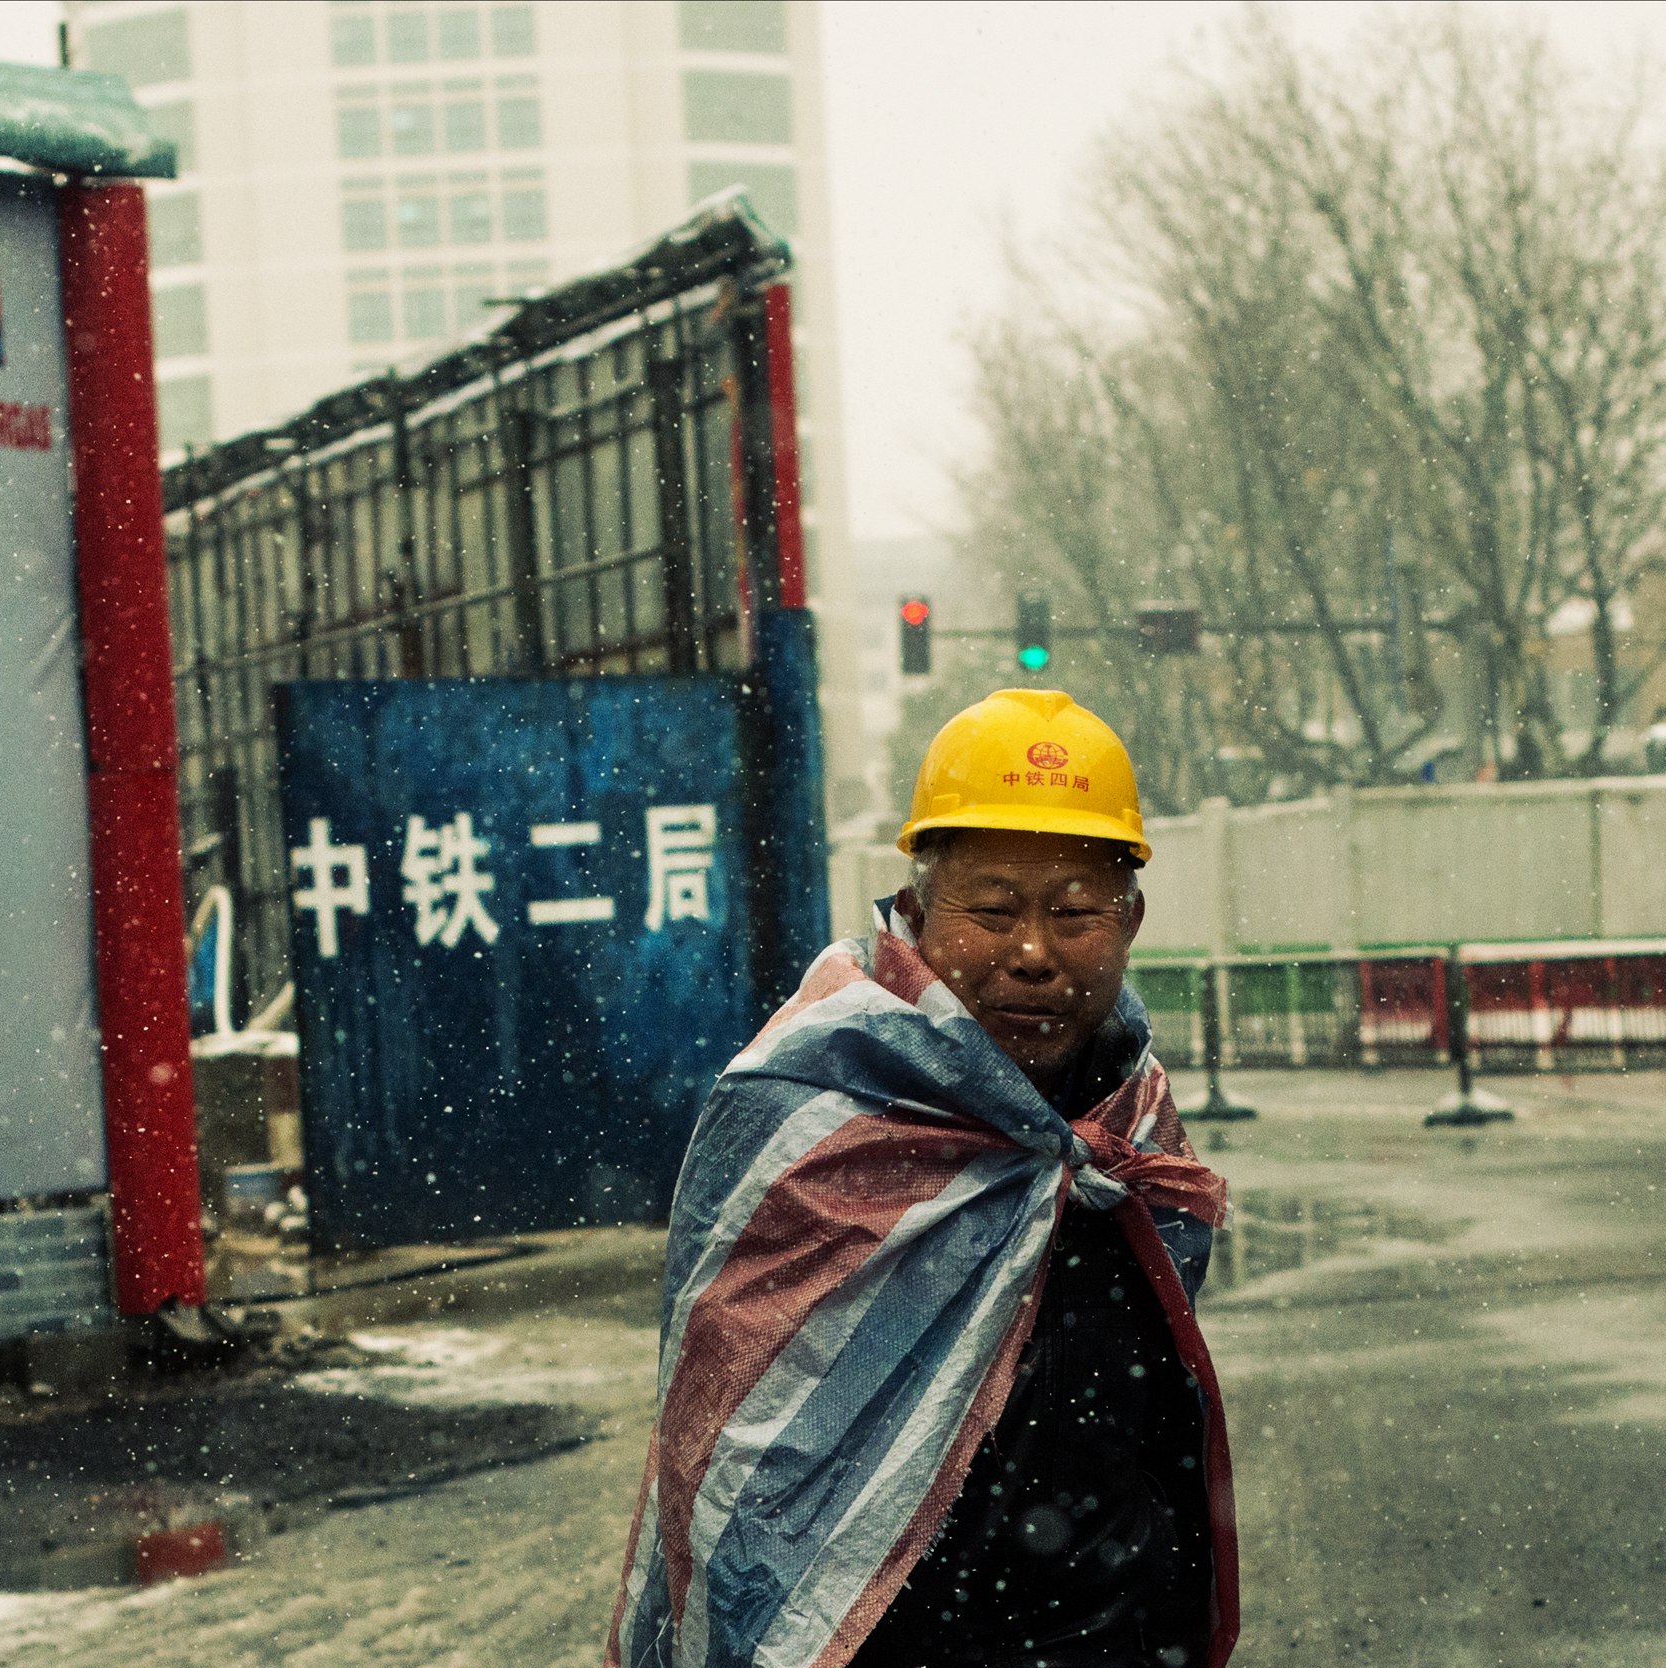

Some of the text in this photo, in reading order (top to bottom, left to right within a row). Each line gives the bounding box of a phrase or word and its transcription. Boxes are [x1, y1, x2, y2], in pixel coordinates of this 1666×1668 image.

[1002, 770, 1090, 792] 中铁四局
[291, 804, 717, 958] 中铁二局
